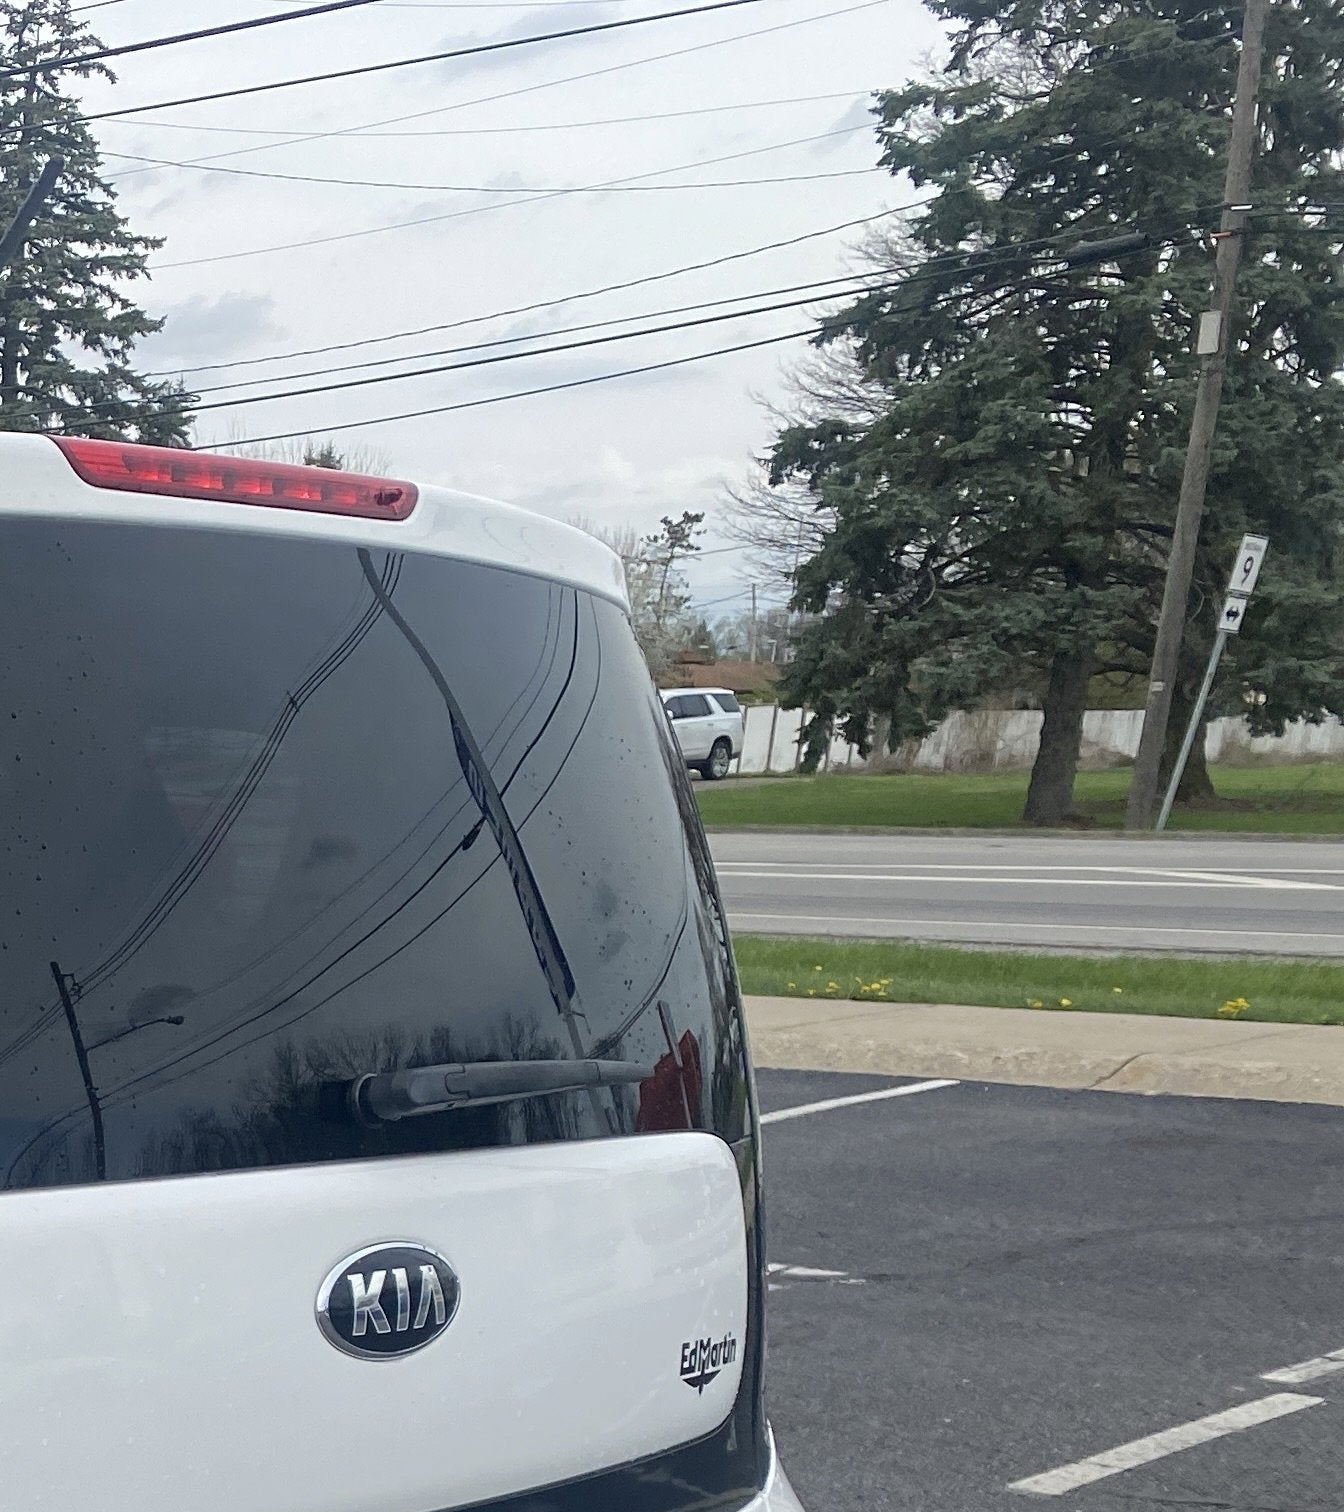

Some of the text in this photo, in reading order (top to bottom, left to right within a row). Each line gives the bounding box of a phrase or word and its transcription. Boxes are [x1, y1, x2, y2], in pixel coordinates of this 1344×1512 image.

[1242, 556, 1254, 585] 9
[347, 1264, 445, 1336] KIA
[679, 1331, 737, 1377] EdMartin
